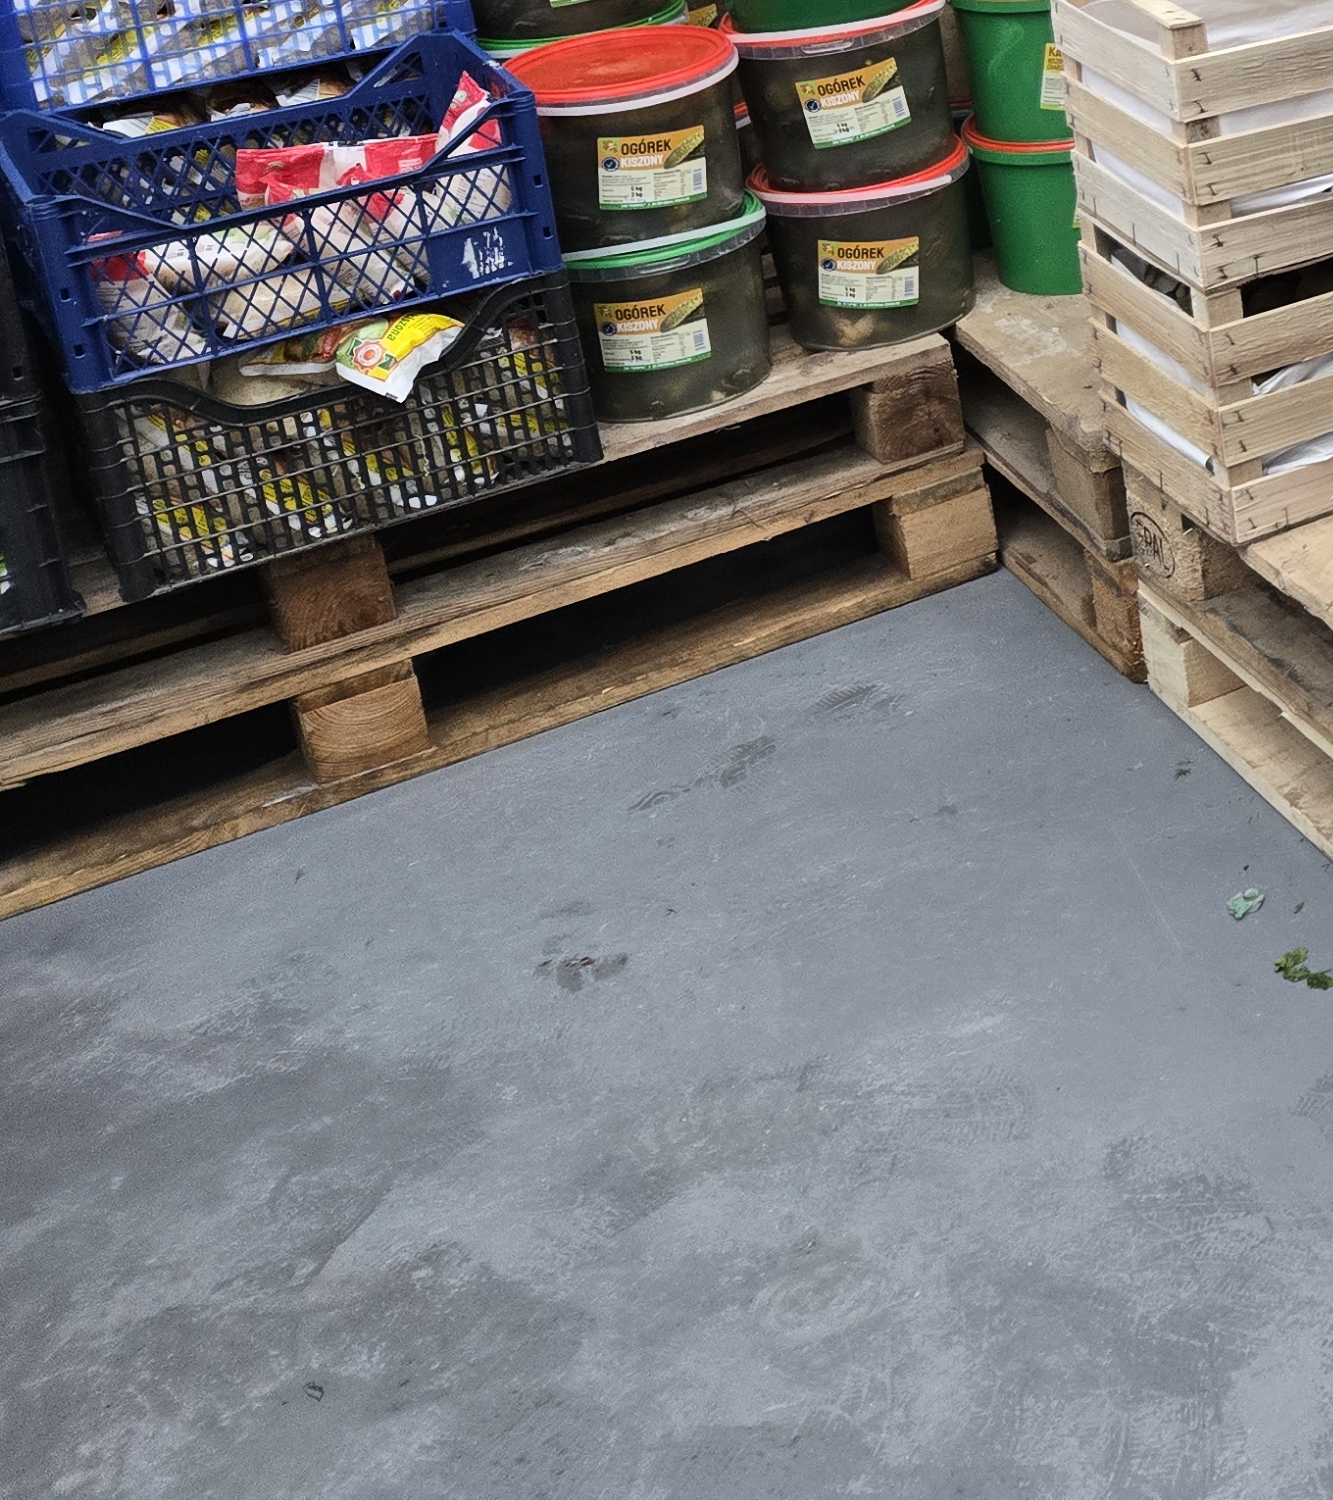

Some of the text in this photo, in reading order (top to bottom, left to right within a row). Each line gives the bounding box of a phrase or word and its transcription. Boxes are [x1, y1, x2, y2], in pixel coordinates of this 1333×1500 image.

[817, 76, 866, 96] OGÓREK
[820, 93, 860, 108] KISZONY
[621, 138, 672, 156] OGÓREK
[620, 155, 663, 169] KISZONY
[837, 246, 884, 260] OGÓREK
[836, 259, 876, 270] KISZONY
[614, 303, 666, 321] OGÓREK
[616, 319, 659, 334] KISZONY
